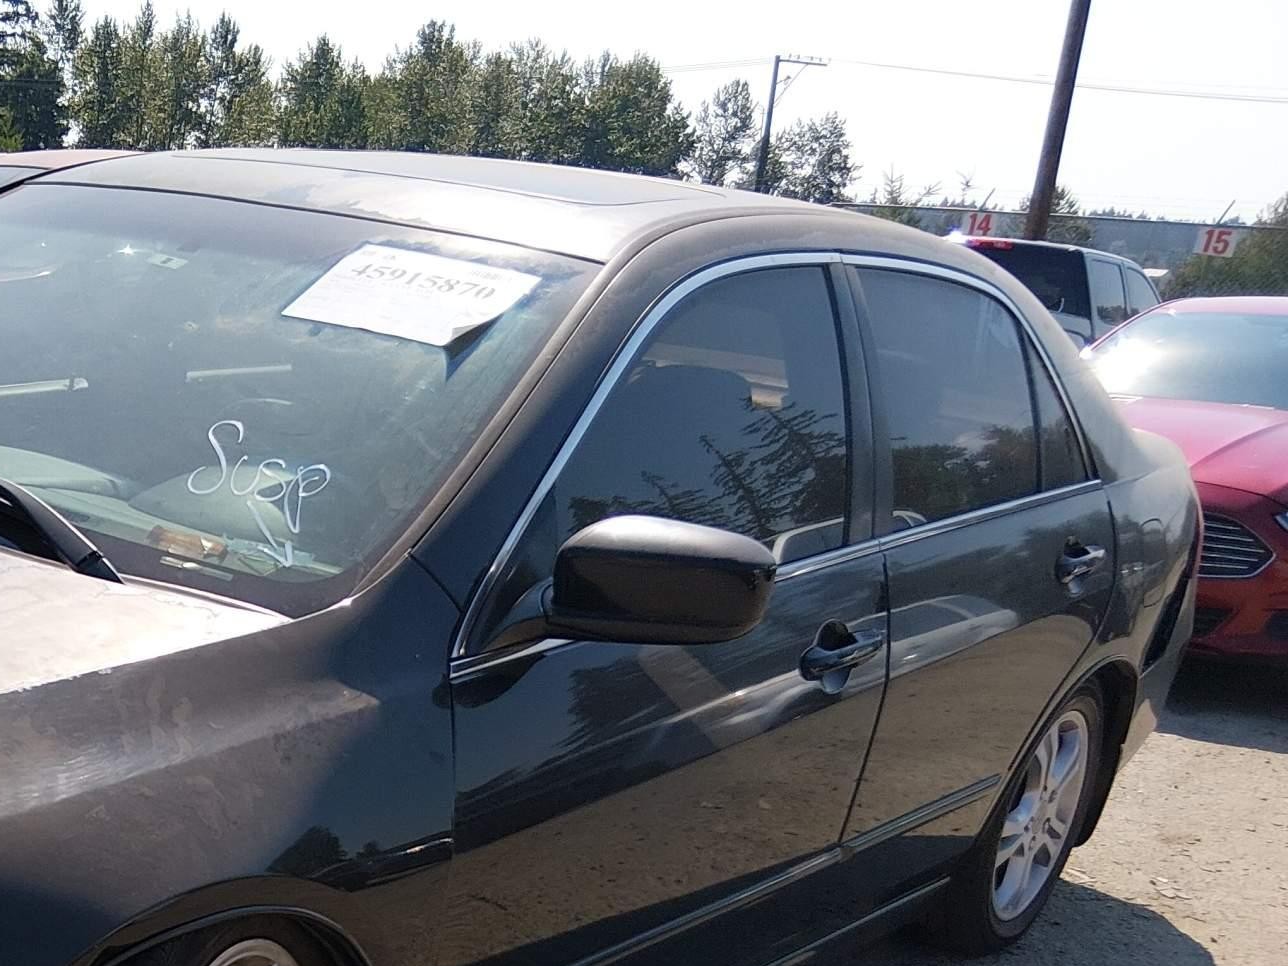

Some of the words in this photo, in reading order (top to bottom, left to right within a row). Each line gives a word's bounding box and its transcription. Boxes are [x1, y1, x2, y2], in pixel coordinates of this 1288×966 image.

[968, 212, 992, 236] 14
[1203, 229, 1232, 254] 15
[351, 263, 497, 300] 45915870
